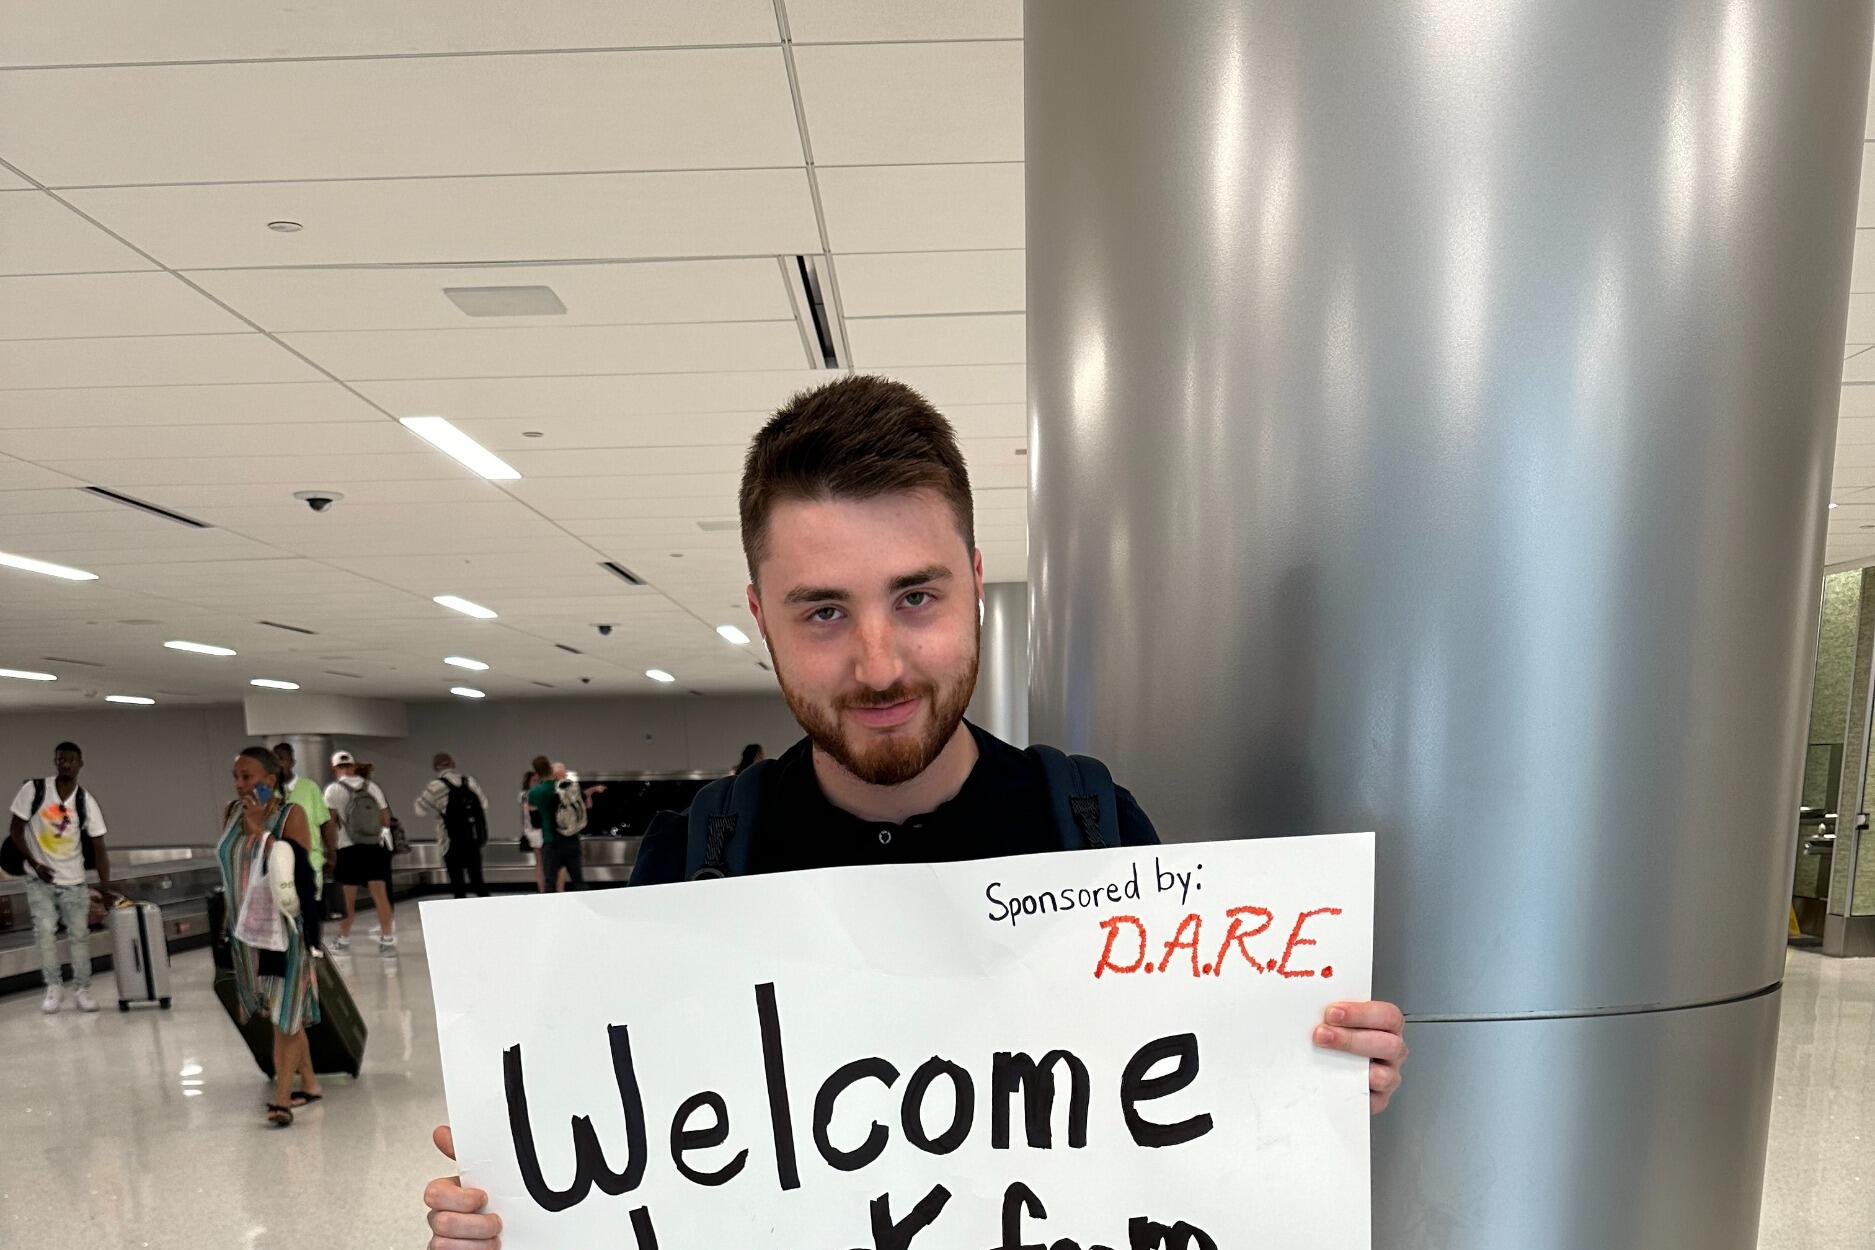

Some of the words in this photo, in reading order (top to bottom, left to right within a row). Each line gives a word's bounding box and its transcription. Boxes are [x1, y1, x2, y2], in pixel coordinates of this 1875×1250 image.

[985, 862, 1141, 926] Sponsored
[1155, 856, 1203, 905] by:
[1094, 905, 1343, 979] D.A.R.E.
[503, 982, 1213, 1213] Welcome
